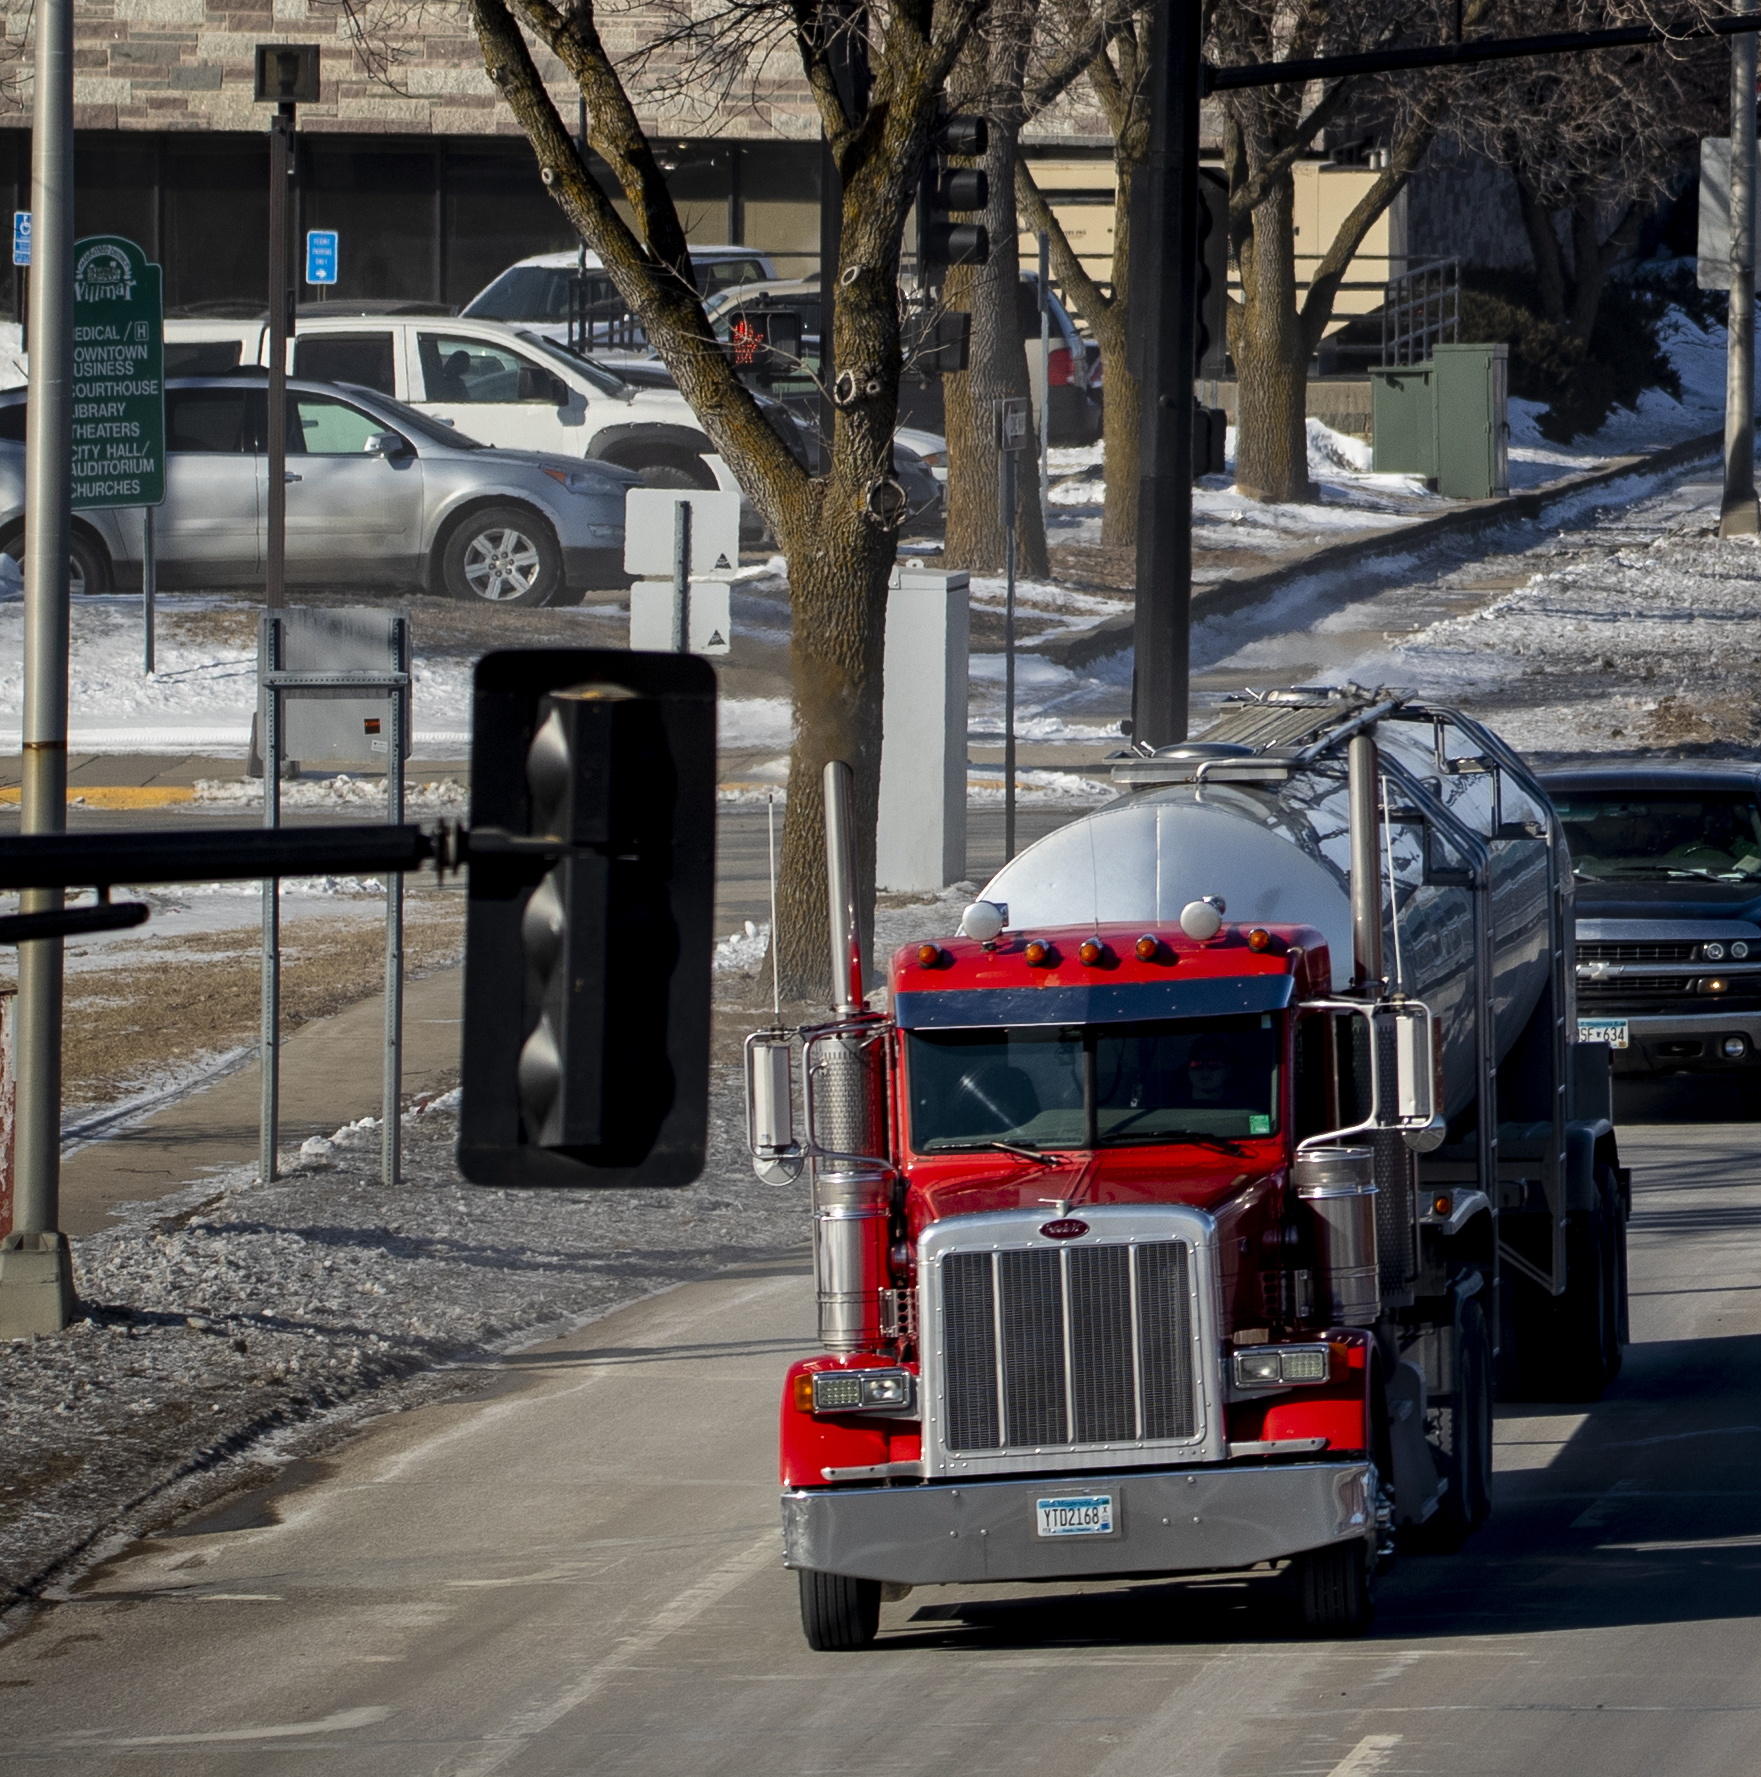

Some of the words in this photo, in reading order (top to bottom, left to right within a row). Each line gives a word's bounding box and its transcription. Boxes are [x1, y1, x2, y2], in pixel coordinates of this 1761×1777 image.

[74, 325, 120, 341] EDICAL
[74, 345, 148, 362] OWNTOWN
[74, 361, 134, 377] USINESS
[72, 380, 158, 398] OURTHOUSE
[72, 402, 126, 418] IBRARY
[71, 458, 154, 476] AUDITORIUM
[1603, 1027, 1625, 1042] 634
[1044, 1506, 1100, 1528] YTD2168
